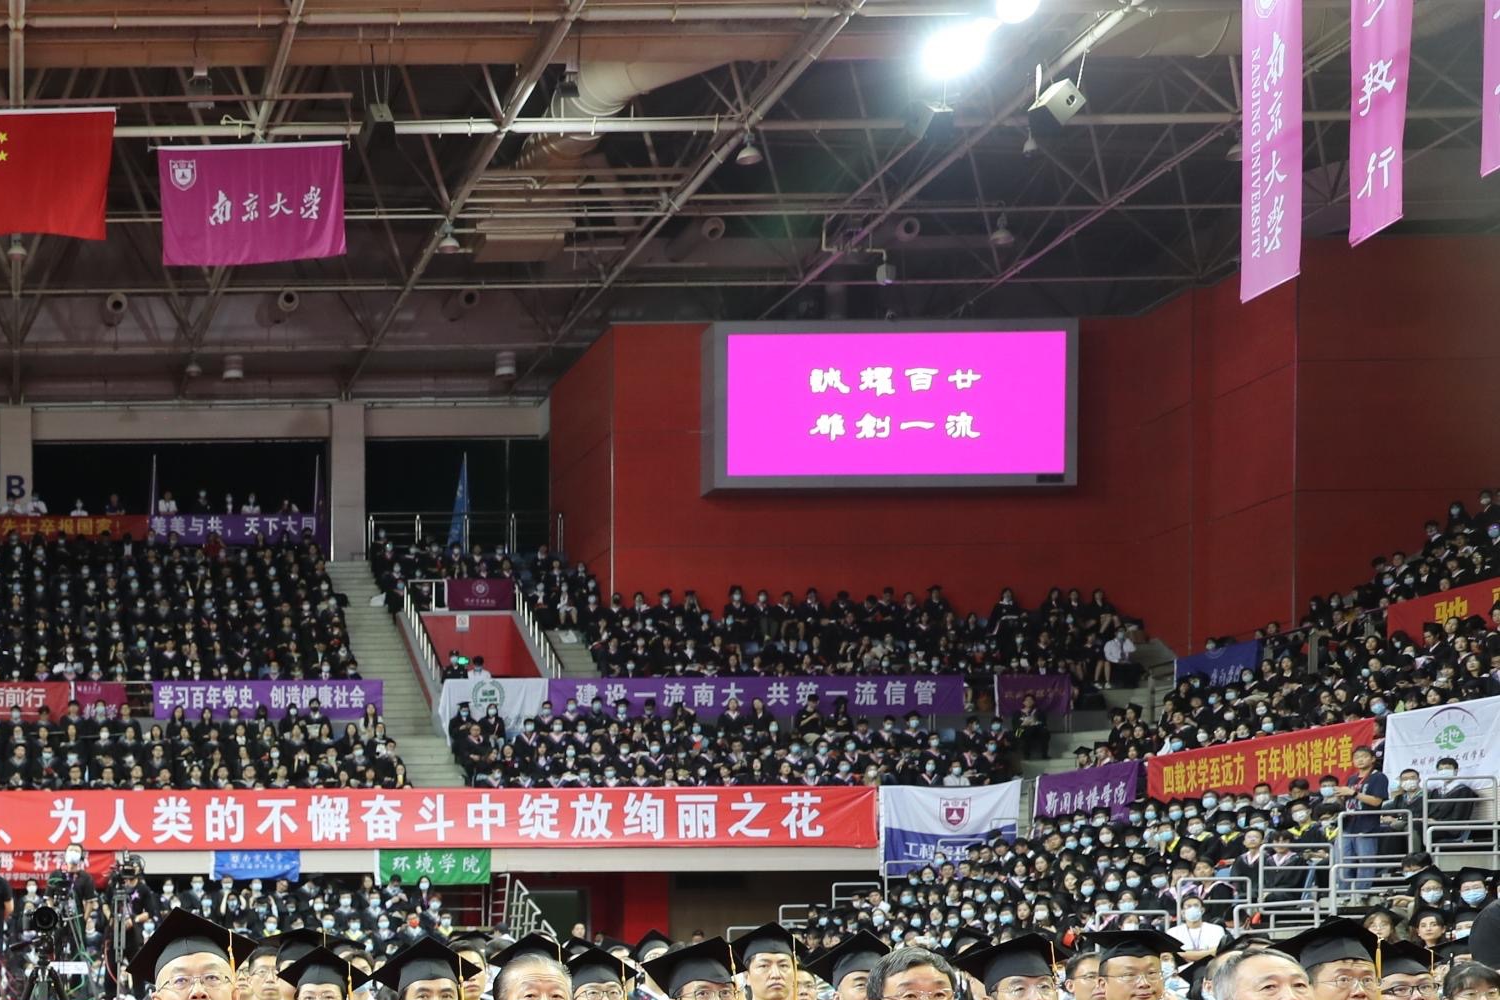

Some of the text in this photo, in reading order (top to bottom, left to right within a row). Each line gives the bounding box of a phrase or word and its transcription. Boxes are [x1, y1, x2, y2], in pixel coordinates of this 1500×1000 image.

[6, 475, 26, 499] B
[575, 682, 744, 707] 建设一流南大
[392, 853, 482, 874] 环境学院
